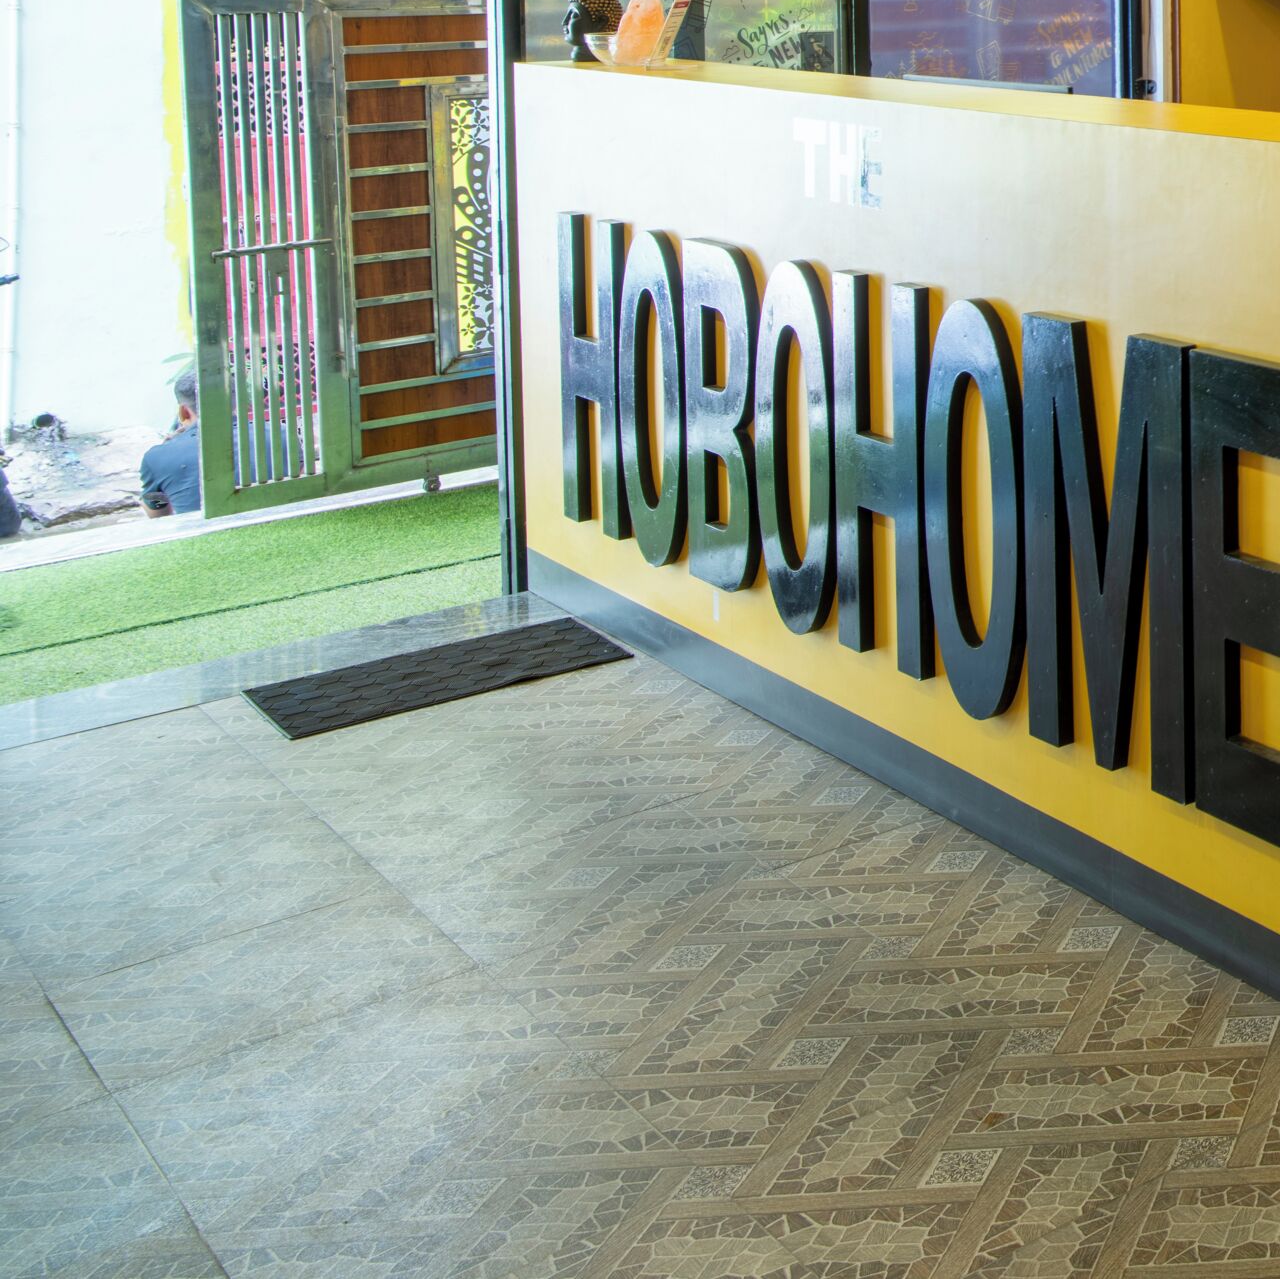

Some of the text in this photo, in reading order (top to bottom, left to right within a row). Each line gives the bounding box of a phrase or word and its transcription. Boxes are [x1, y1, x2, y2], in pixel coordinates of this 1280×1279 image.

[737, 26, 774, 58] Say
[764, 13, 789, 34] YES
[768, 35, 807, 68] NEW
[792, 117, 882, 209] THE
